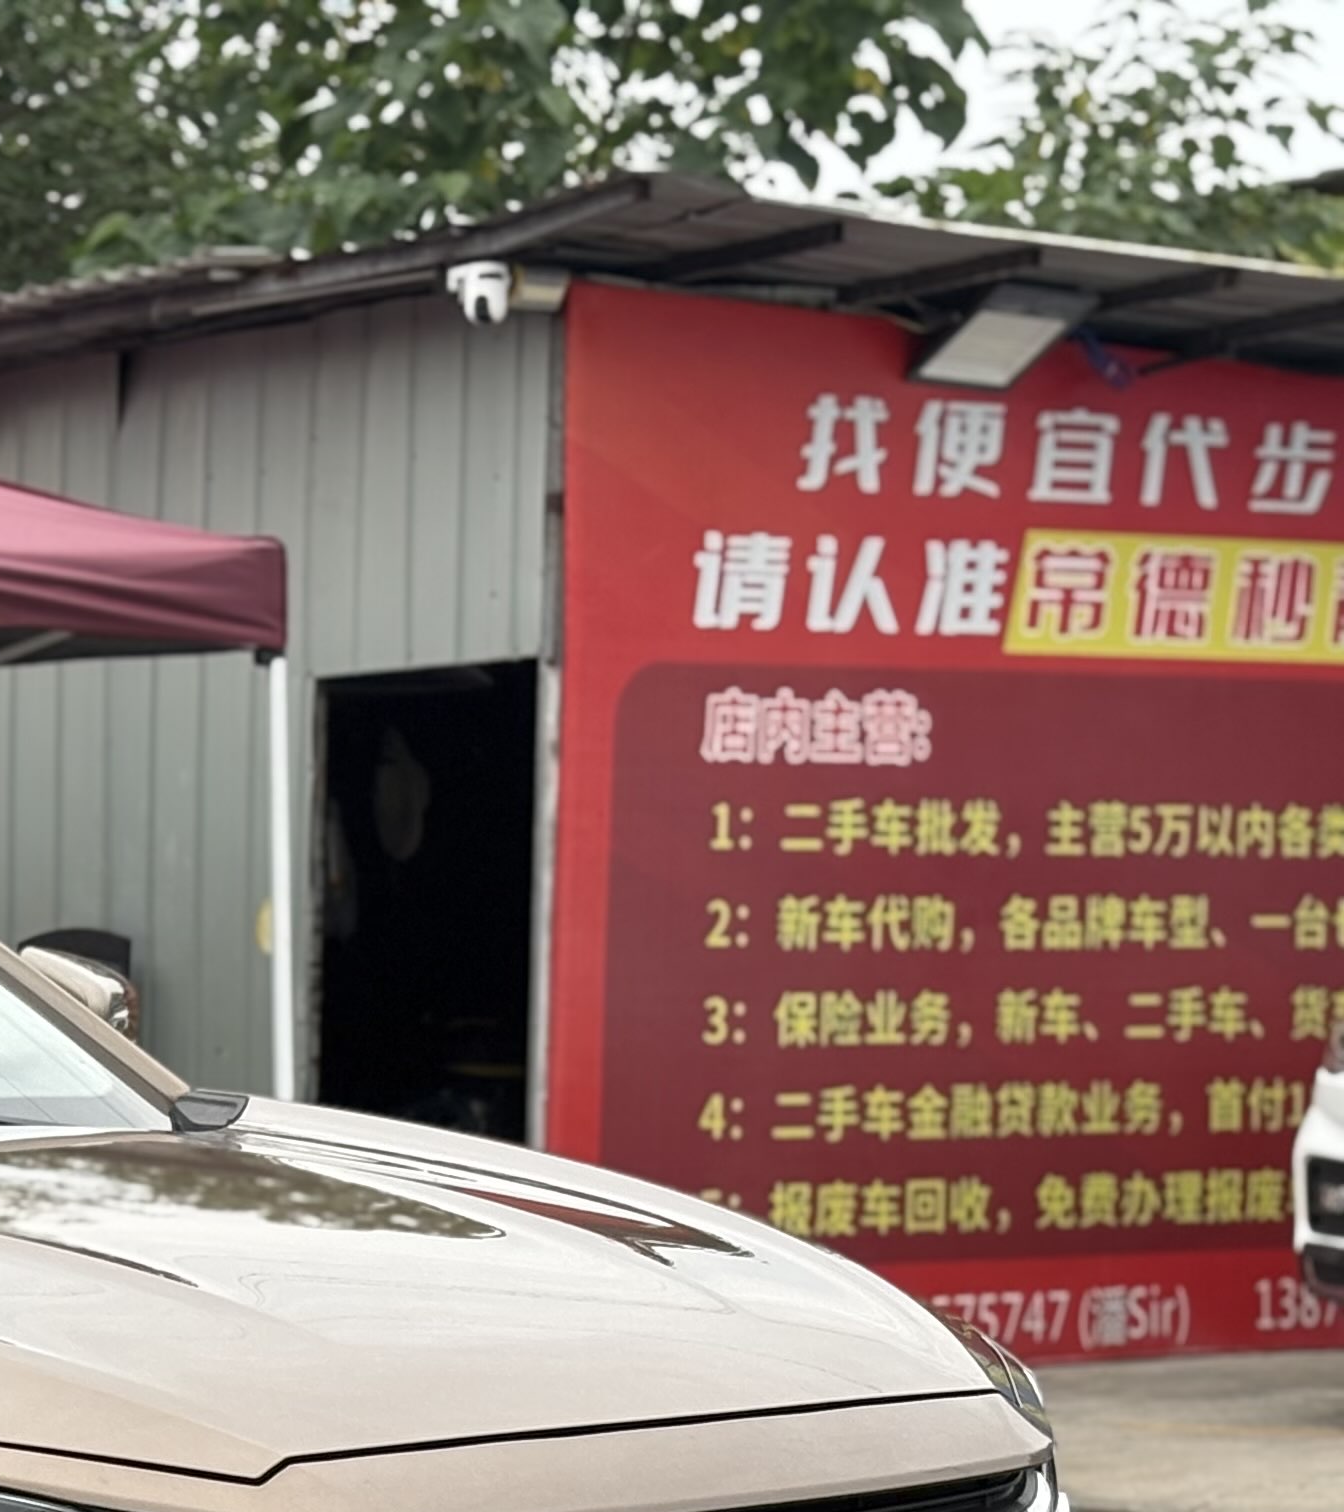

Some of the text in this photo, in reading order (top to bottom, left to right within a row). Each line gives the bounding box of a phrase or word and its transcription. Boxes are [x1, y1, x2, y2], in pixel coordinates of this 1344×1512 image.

[796, 394, 1338, 517] 找便宜代步
[693, 530, 1344, 648] 请认准常德秒
[705, 894, 1344, 954] 2：新车代购，各品牌车型、一台
[702, 986, 1344, 1047] 3：保险业务，新车、二手车、货
[698, 1079, 1310, 1143] 4：二手车金融贷款业务，首付1
